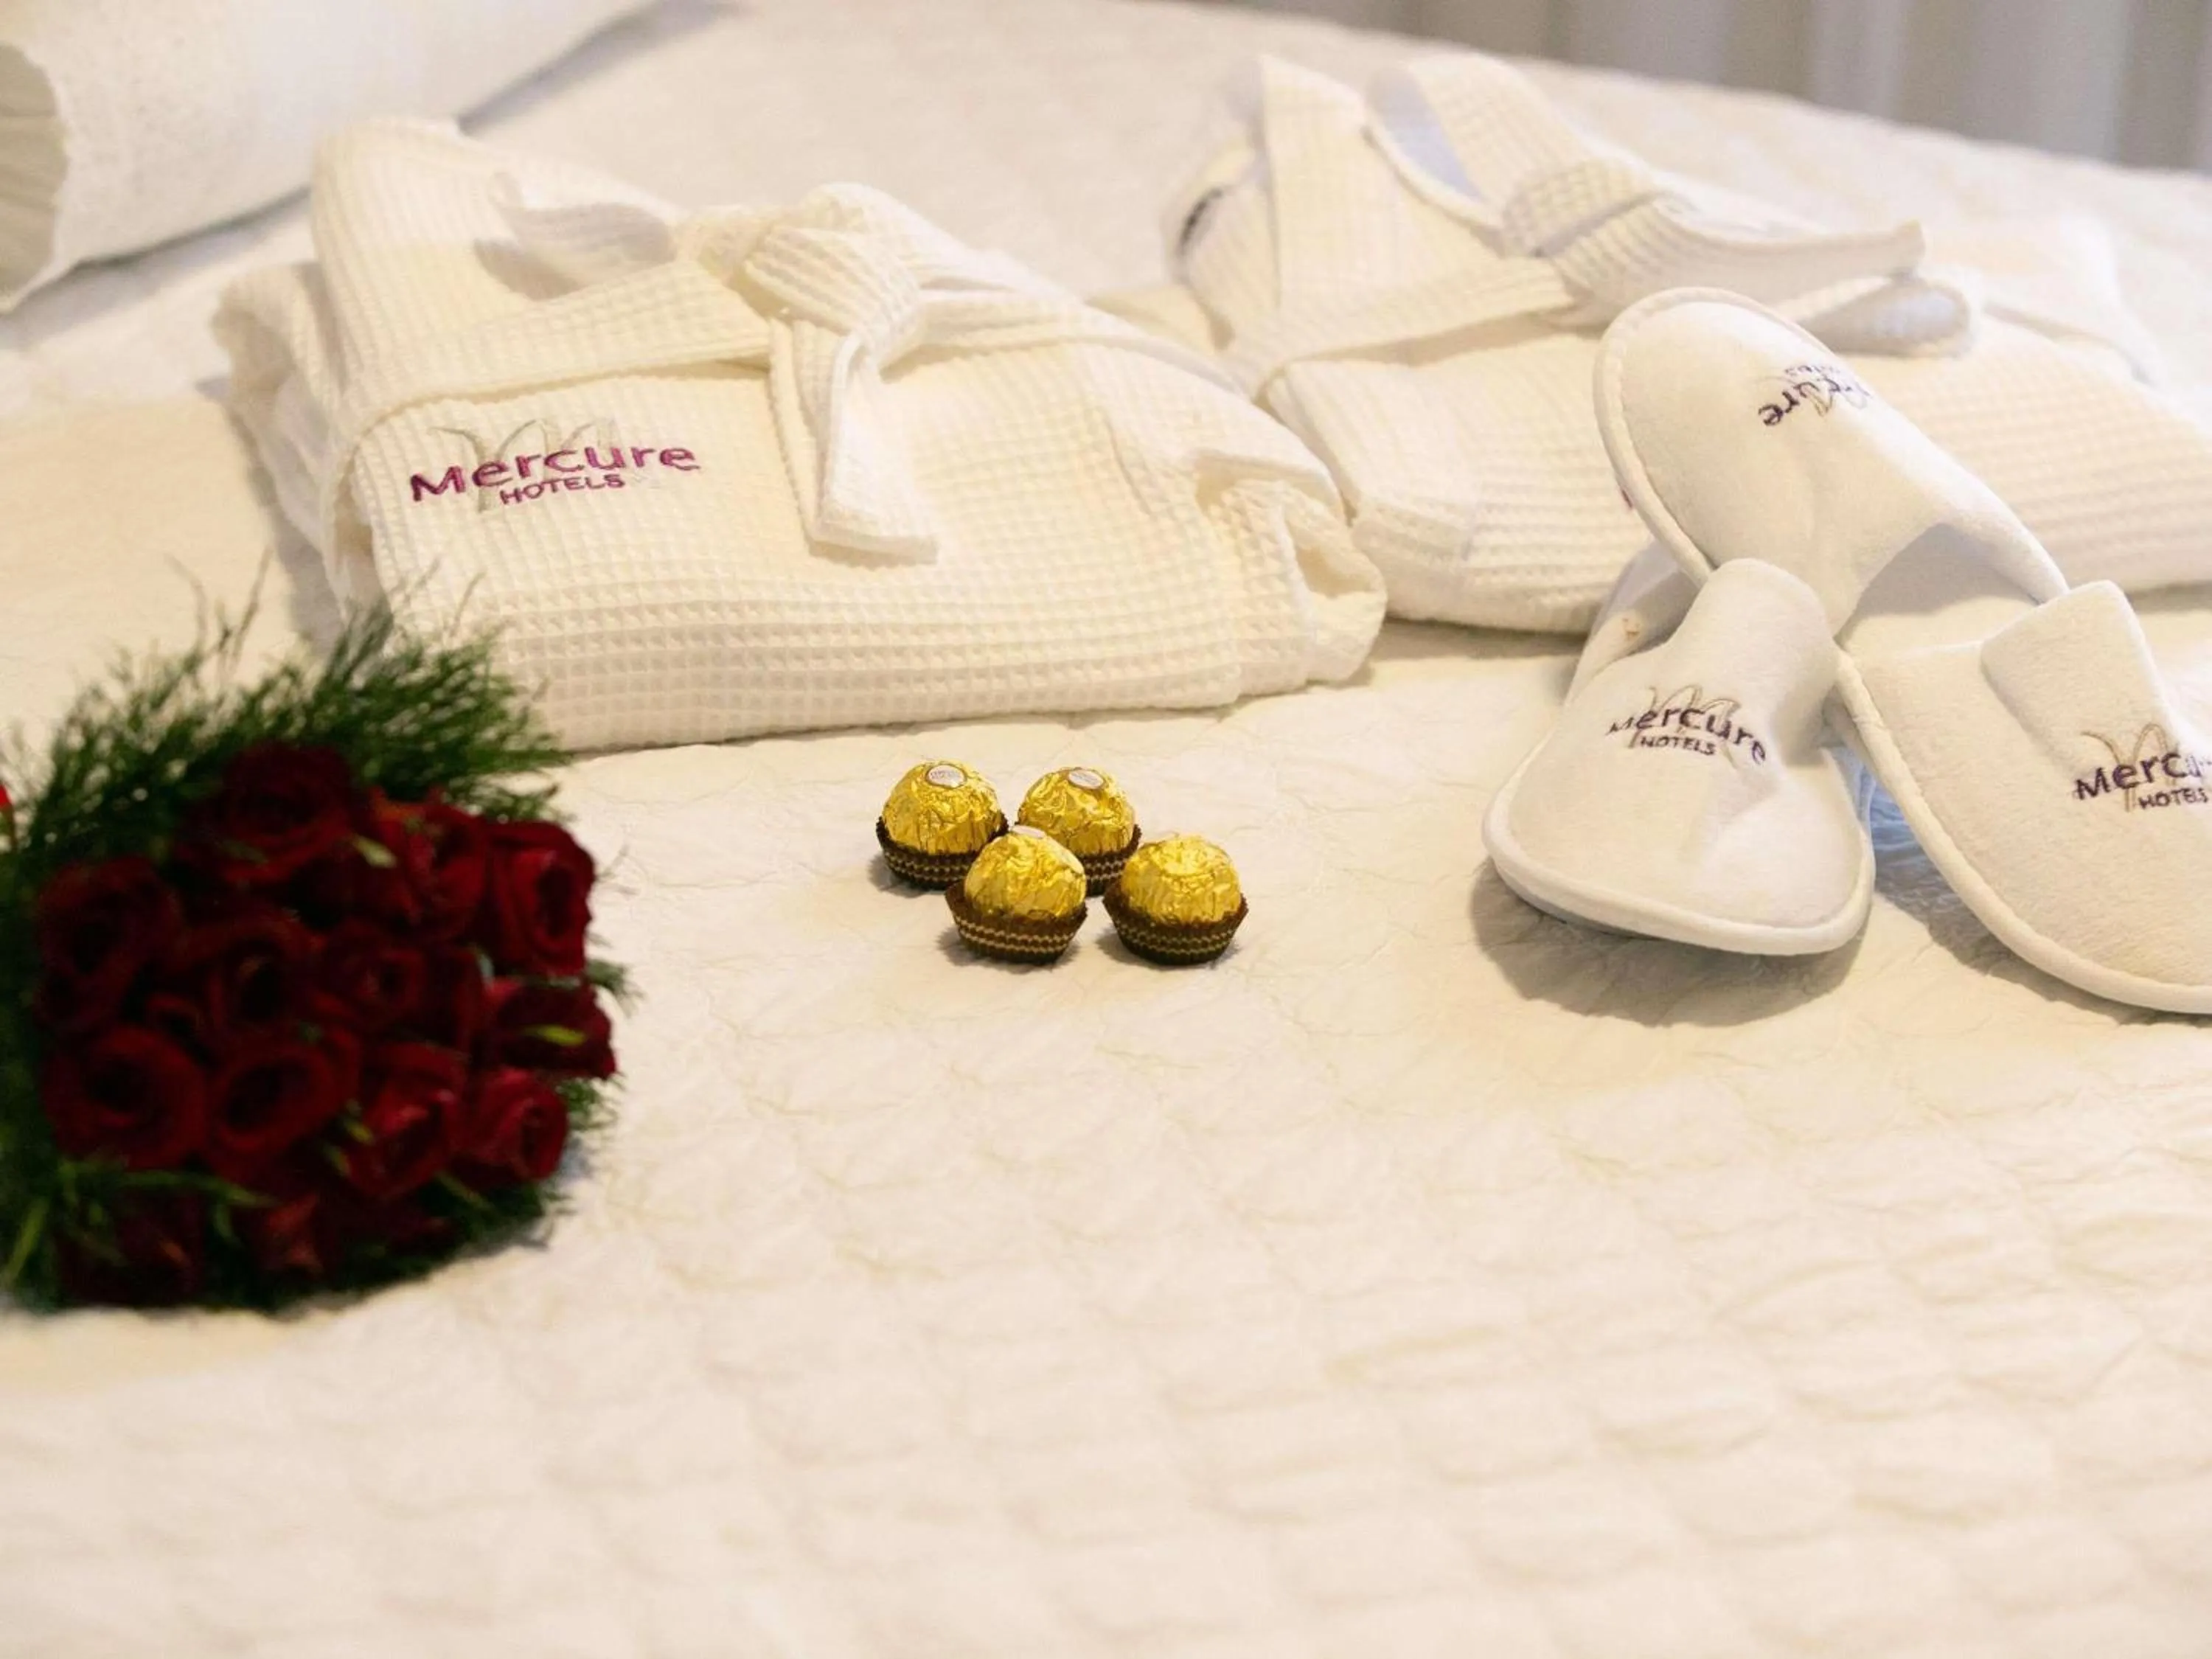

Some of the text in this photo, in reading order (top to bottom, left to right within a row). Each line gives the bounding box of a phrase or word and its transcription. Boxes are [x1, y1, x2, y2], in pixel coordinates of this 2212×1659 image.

[409, 446, 700, 503] Mercure
[499, 473, 626, 505] HOTELS
[1604, 707, 1766, 765] Mercure
[1641, 735, 1717, 756] HOTELS
